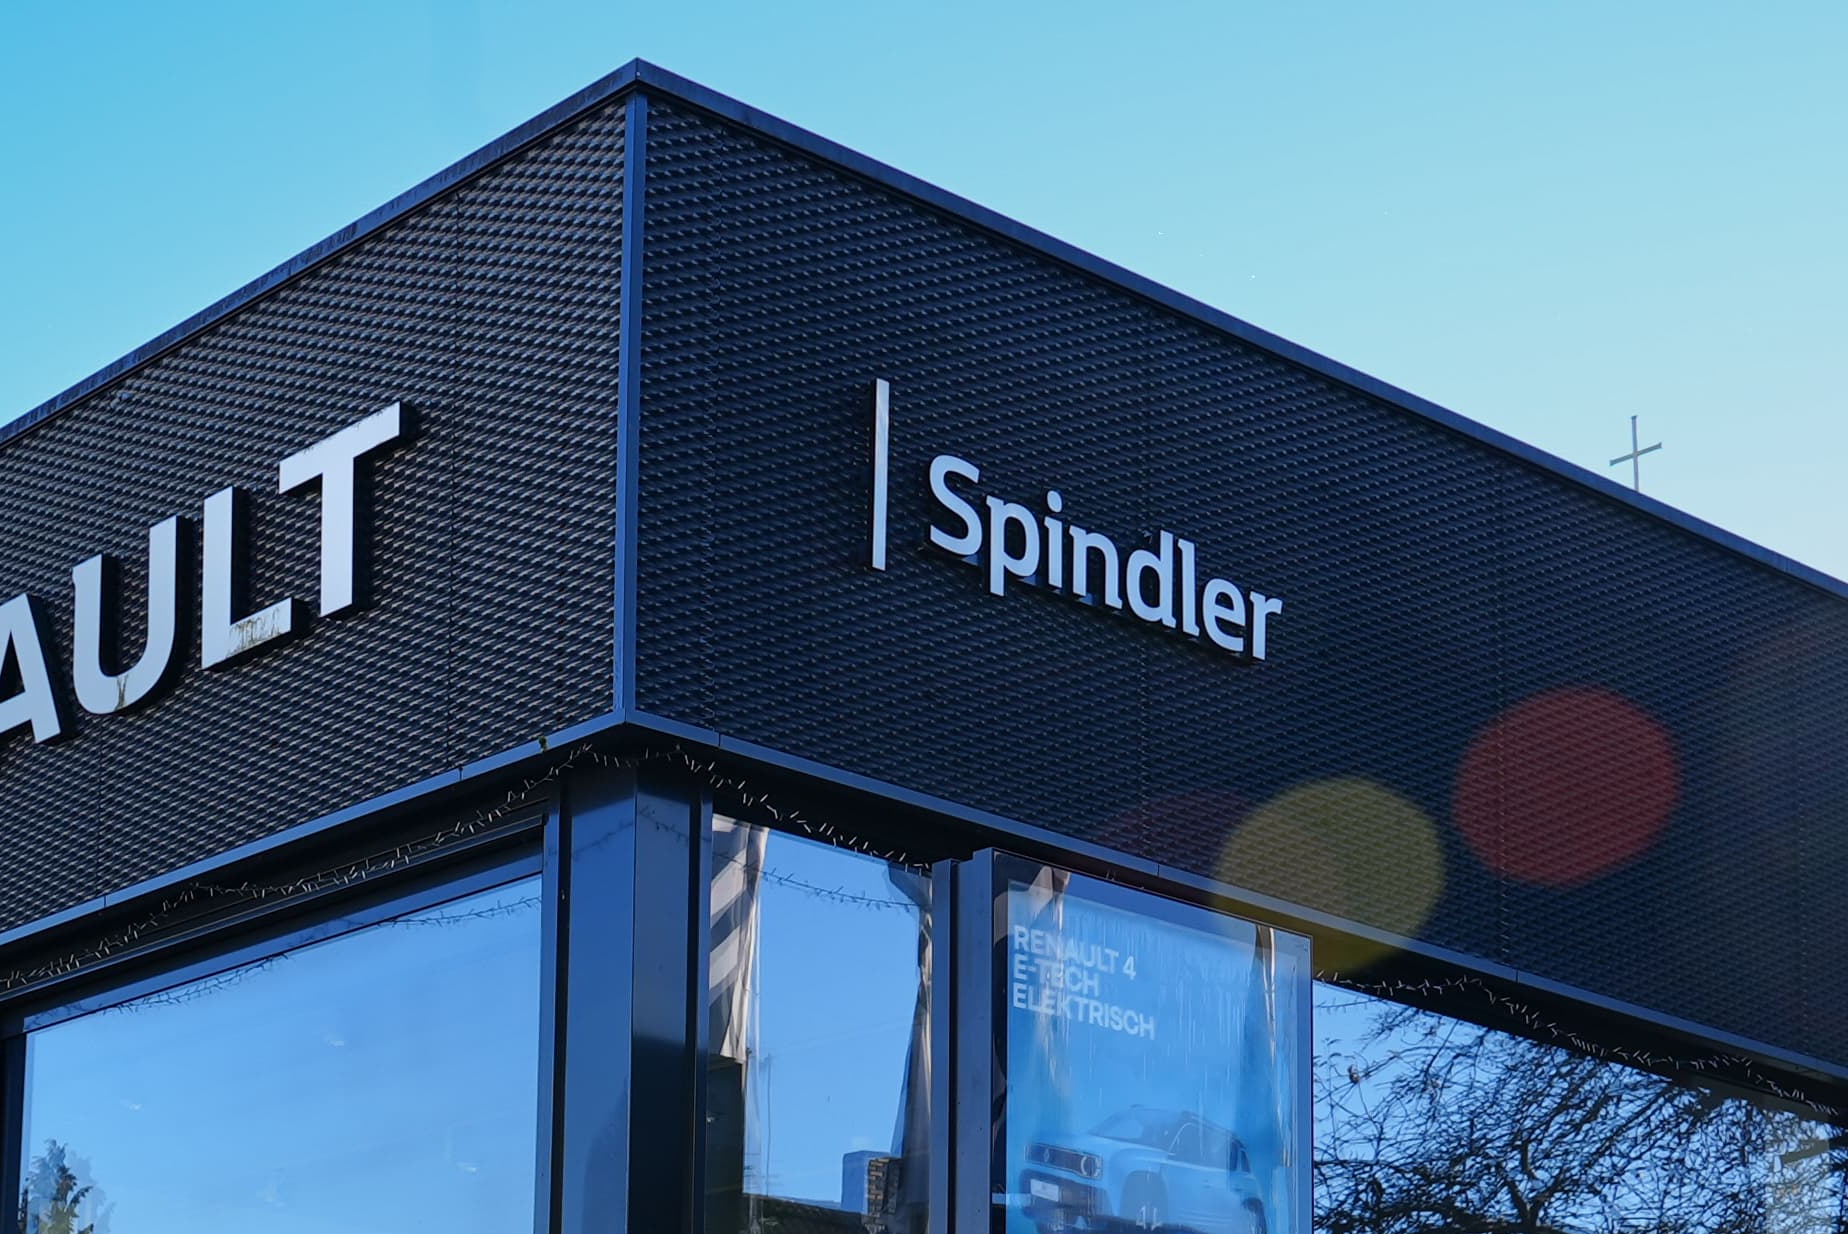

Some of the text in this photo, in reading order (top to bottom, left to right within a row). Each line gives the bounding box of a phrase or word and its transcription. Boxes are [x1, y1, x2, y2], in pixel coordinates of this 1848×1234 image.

[929, 454, 1283, 661] Spindler
[1013, 925, 1137, 981] RENAULT 4
[1014, 953, 1099, 997] E-TECH
[1013, 982, 1154, 1040] ELEKTRISCH
